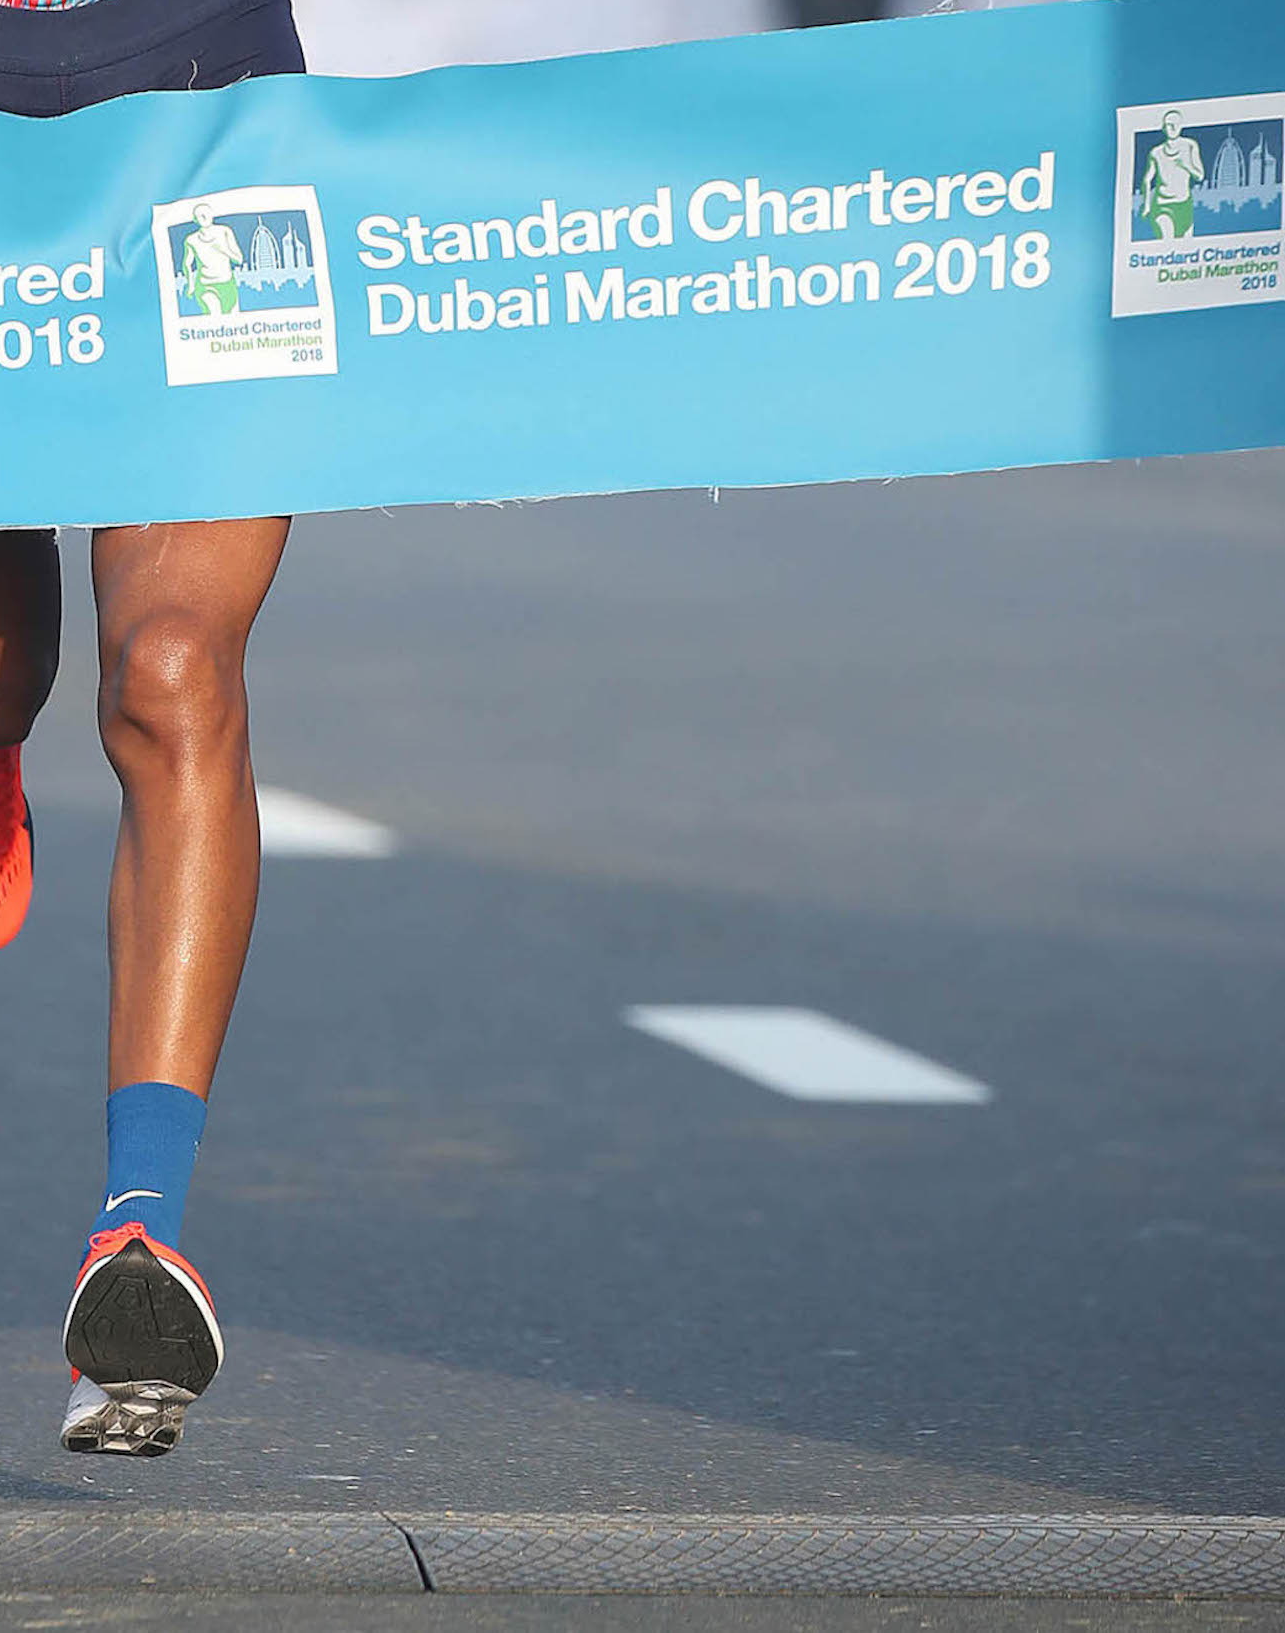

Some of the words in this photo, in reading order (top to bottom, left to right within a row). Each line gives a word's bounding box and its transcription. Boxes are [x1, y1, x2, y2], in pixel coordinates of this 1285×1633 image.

[356, 186, 674, 270] Standard
[687, 151, 1055, 242] Chartered
[1129, 248, 1201, 267] Standard
[1203, 241, 1282, 262] Chartered
[1157, 264, 1202, 282] Dubai
[1205, 260, 1279, 278] Marathon
[366, 274, 550, 336] Dubai
[564, 255, 880, 323] Marathon
[893, 231, 1051, 299] 2018
[1241, 274, 1278, 291] 2018
[179, 323, 249, 341] Standard
[252, 318, 322, 335] Chartered
[210, 339, 254, 354] Dubai
[257, 334, 323, 350] Marathon
[291, 348, 324, 363] 2018
